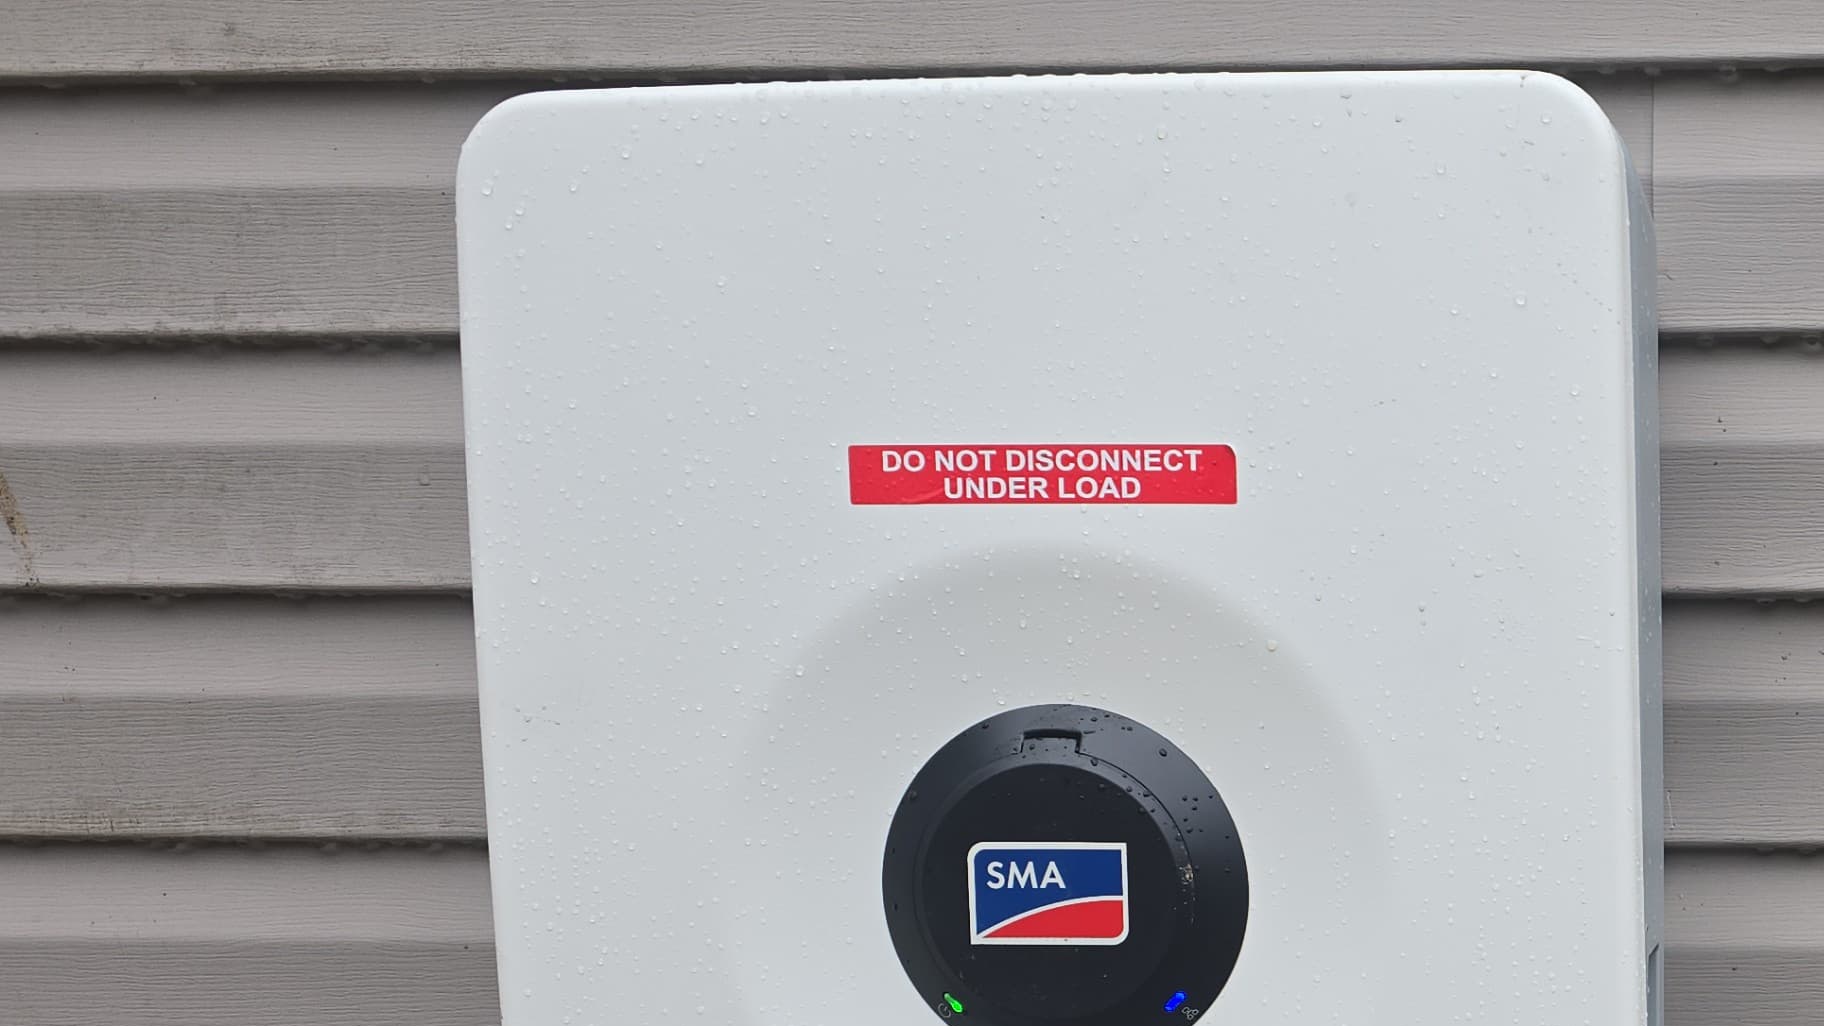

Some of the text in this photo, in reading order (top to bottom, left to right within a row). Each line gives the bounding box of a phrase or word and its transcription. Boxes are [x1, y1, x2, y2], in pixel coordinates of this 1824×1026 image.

[882, 449, 1202, 472] DO NOT DISCONNECT
[943, 477, 1141, 499] UNDER LOAD
[986, 860, 1066, 890] SMA
